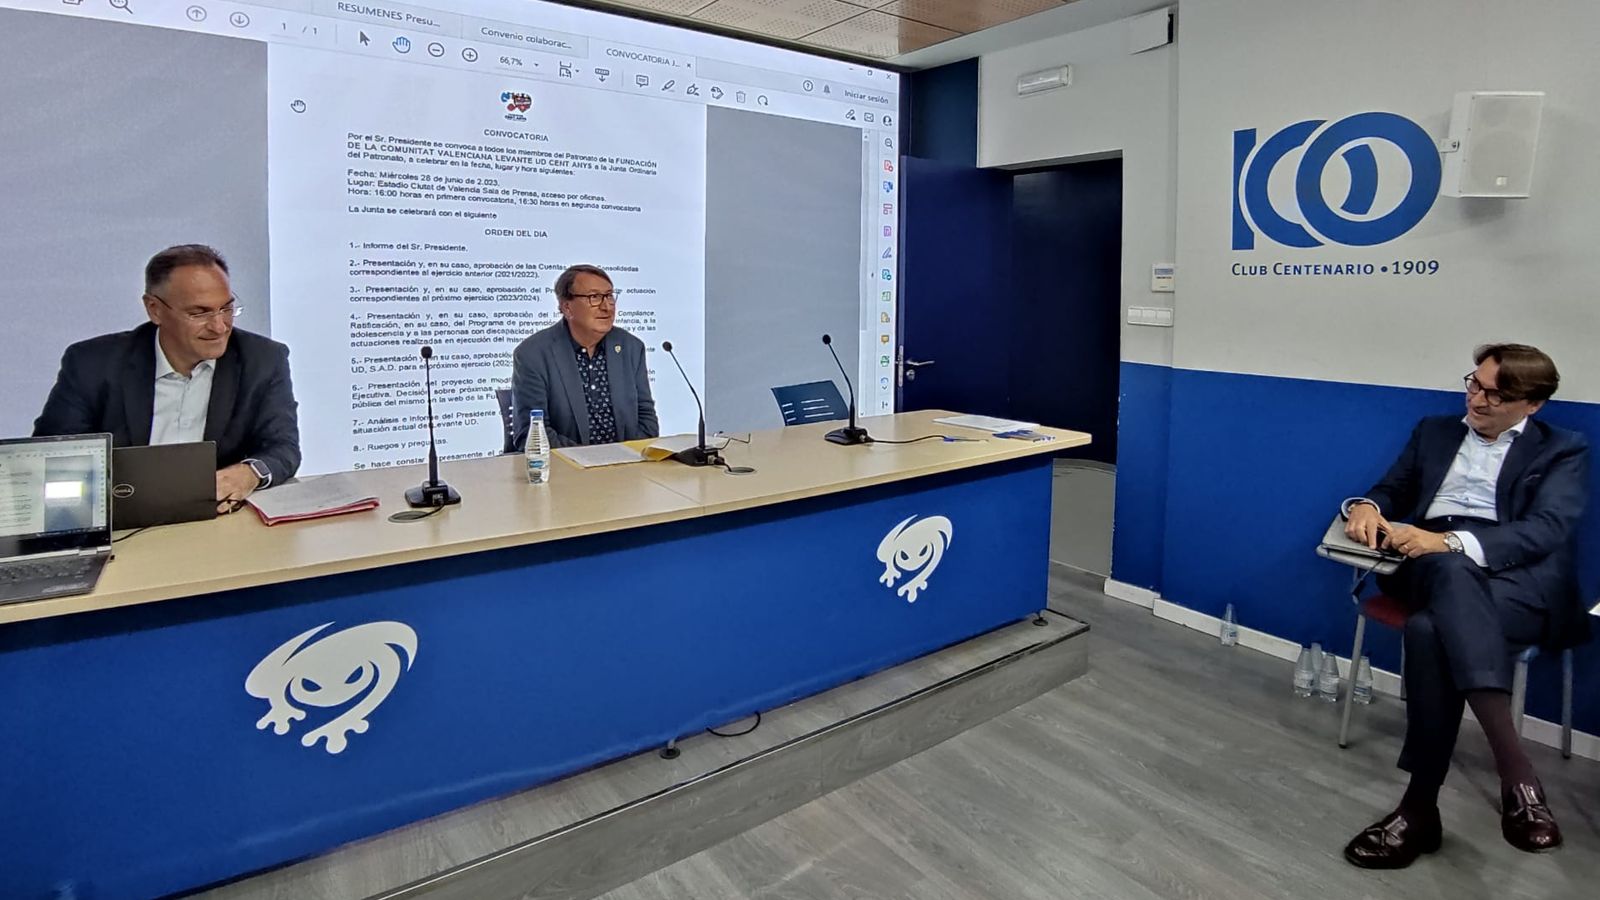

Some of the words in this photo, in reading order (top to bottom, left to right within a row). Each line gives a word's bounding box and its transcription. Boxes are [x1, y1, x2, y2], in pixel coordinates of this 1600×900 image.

[337, 2, 402, 20] RESUMENES
[481, 26, 524, 43] Convenio
[500, 55, 523, 68] 66,7%
[606, 48, 670, 66] CONVOCATORIA
[845, 90, 866, 99] Iniciar
[868, 94, 888, 104] sesión
[484, 130, 548, 141] CONVOCATORIA
[389, 136, 431, 147] Presidente
[445, 143, 476, 151] convoca
[518, 149, 552, 157] miembros
[566, 153, 598, 162] Patronato
[616, 158, 657, 168] FUNDACIÓN
[363, 152, 406, 163] Patronato,
[416, 156, 448, 165] celebrar
[471, 160, 493, 169] fecha,
[495, 163, 514, 172] lugar
[539, 167, 575, 176] siguientes:
[381, 145, 434, 155] COMUNITAT
[438, 150, 492, 160] VALENCIANA
[496, 155, 532, 164] LEVANTE
[629, 167, 656, 175] Ordinaria
[348, 169, 377, 177] Fecha:
[380, 171, 418, 180] Miércoles
[348, 179, 375, 187] Lugar:
[378, 180, 408, 189] Estadio
[448, 186, 480, 194] Valencia
[512, 190, 539, 198] Prensa,
[468, 196, 517, 205] convocatoria,
[602, 204, 641, 212] convocatoria
[399, 208, 436, 216] celebrará
[1232, 262, 1267, 276] CLUB
[1273, 262, 1374, 276] CENTENARIO
[1393, 260, 1440, 275] 1909
[351, 330, 404, 338] adolescencia
[351, 339, 400, 347] actuaciones
[364, 355, 417, 363] Presentación
[368, 381, 420, 390] Presentación
[442, 378, 473, 386] proyecto
[352, 392, 392, 401] Ejecutiva.
[352, 400, 382, 409] pública
[456, 410, 496, 418] Presidente
[353, 426, 390, 434] situación
[367, 442, 399, 450] Ruegos
[396, 457, 425, 465] constar
